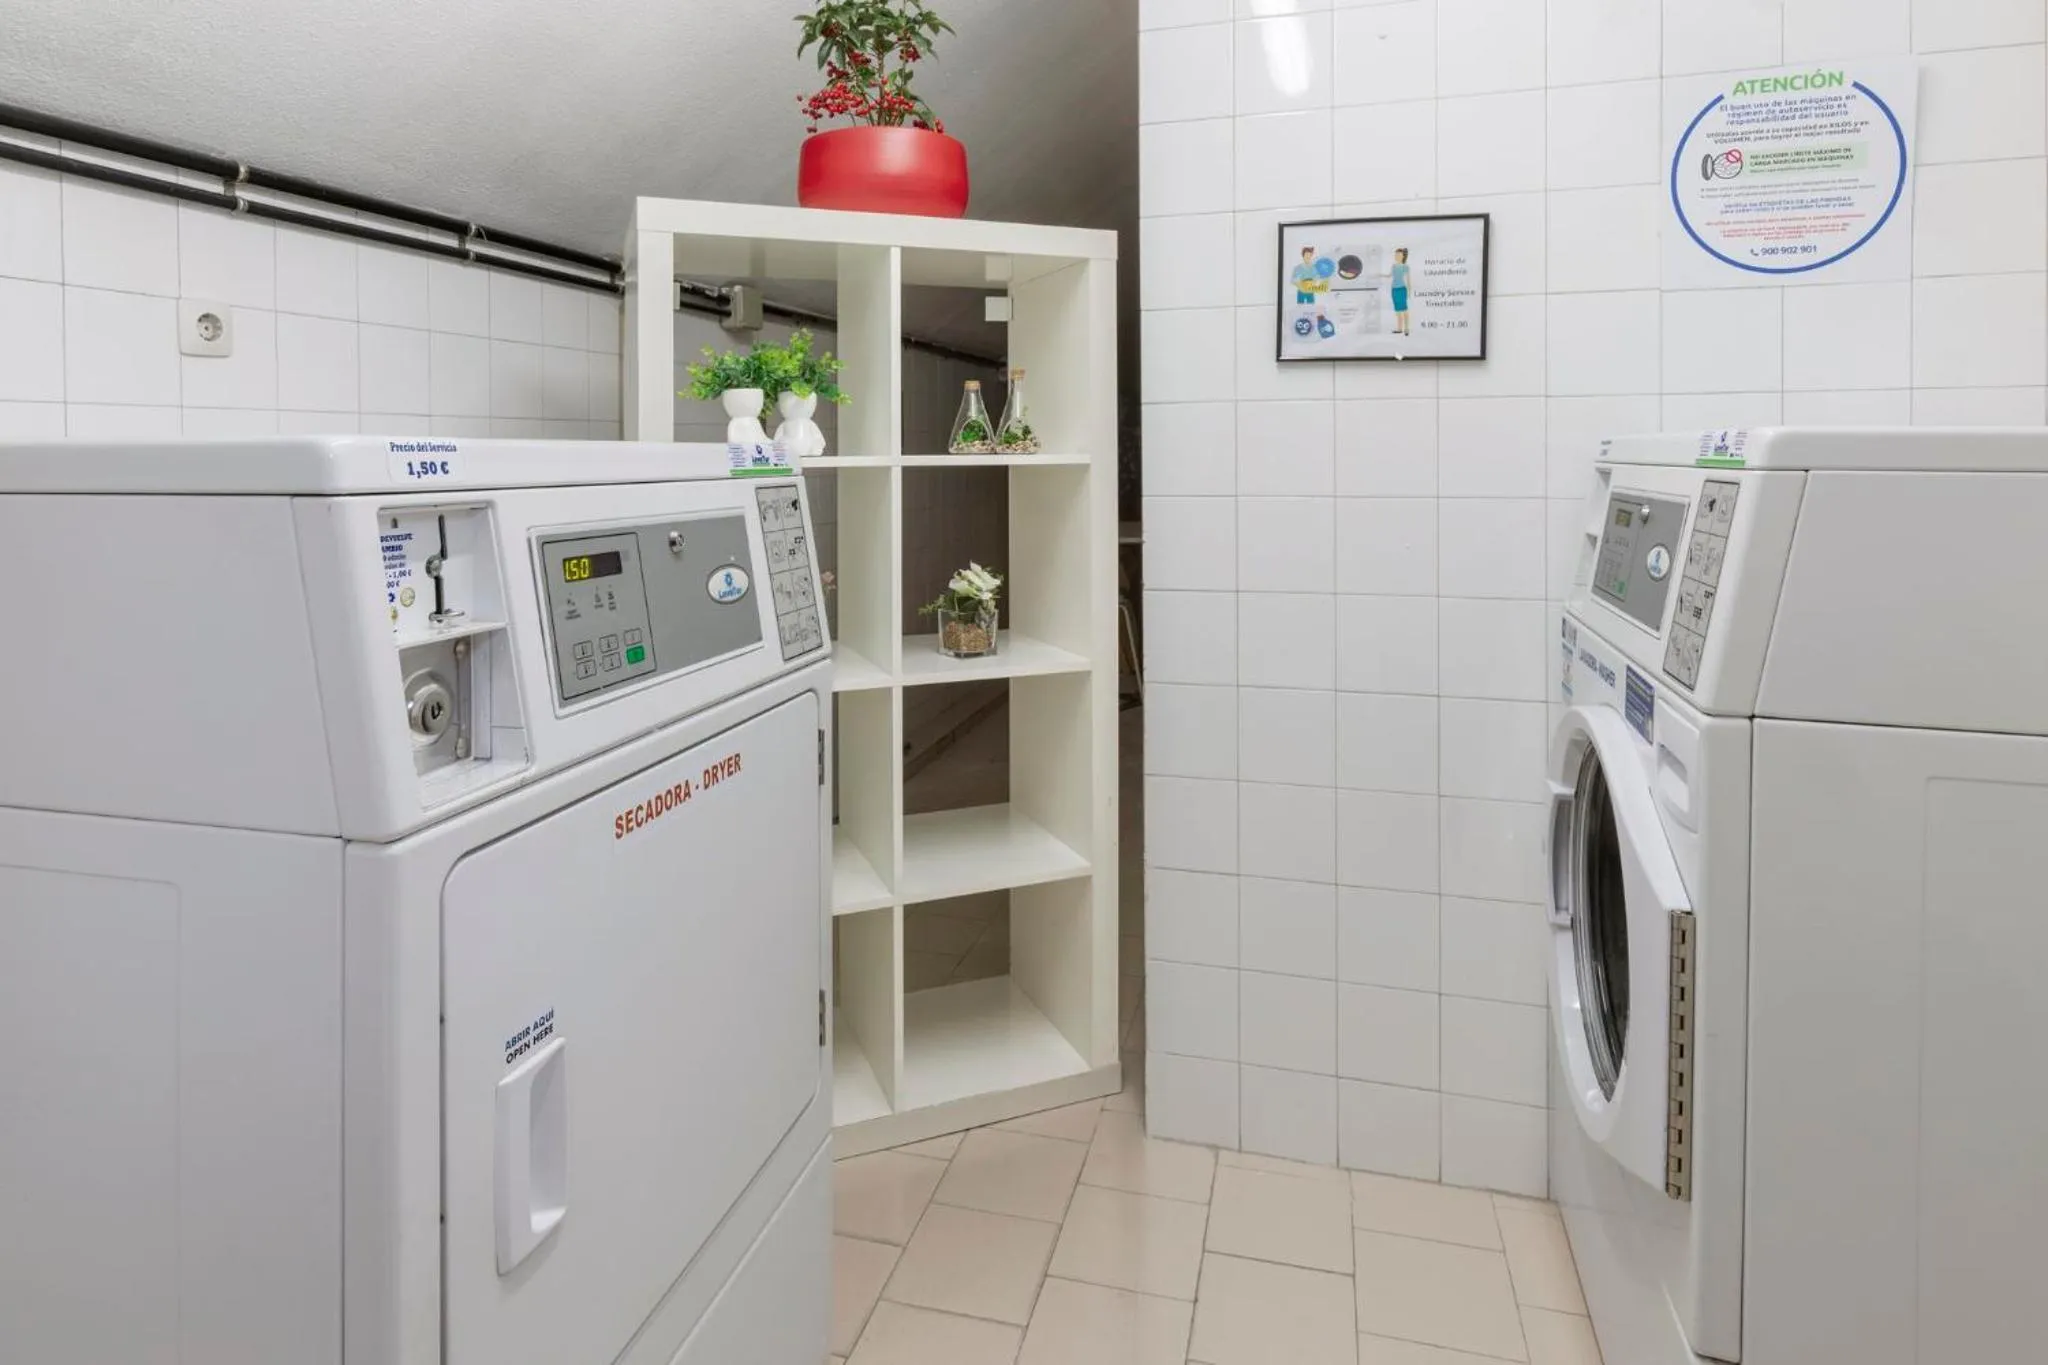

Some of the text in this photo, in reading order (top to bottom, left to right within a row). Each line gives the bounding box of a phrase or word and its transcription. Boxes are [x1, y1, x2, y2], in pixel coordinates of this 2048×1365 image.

[1732, 68, 1844, 95] ATENCIÓN
[1760, 244, 1817, 256] 900 902 901
[1414, 288, 1475, 299] Laundry Service
[389, 440, 457, 454] Precio del Servicio
[407, 460, 449, 479] 1,50 €
[380, 533, 414, 543] DEVUELVE
[615, 779, 692, 839] SECADORA
[703, 753, 741, 790] DRYER
[505, 1026, 531, 1052] ABRIR
[506, 1022, 554, 1065] OPEN HERE
